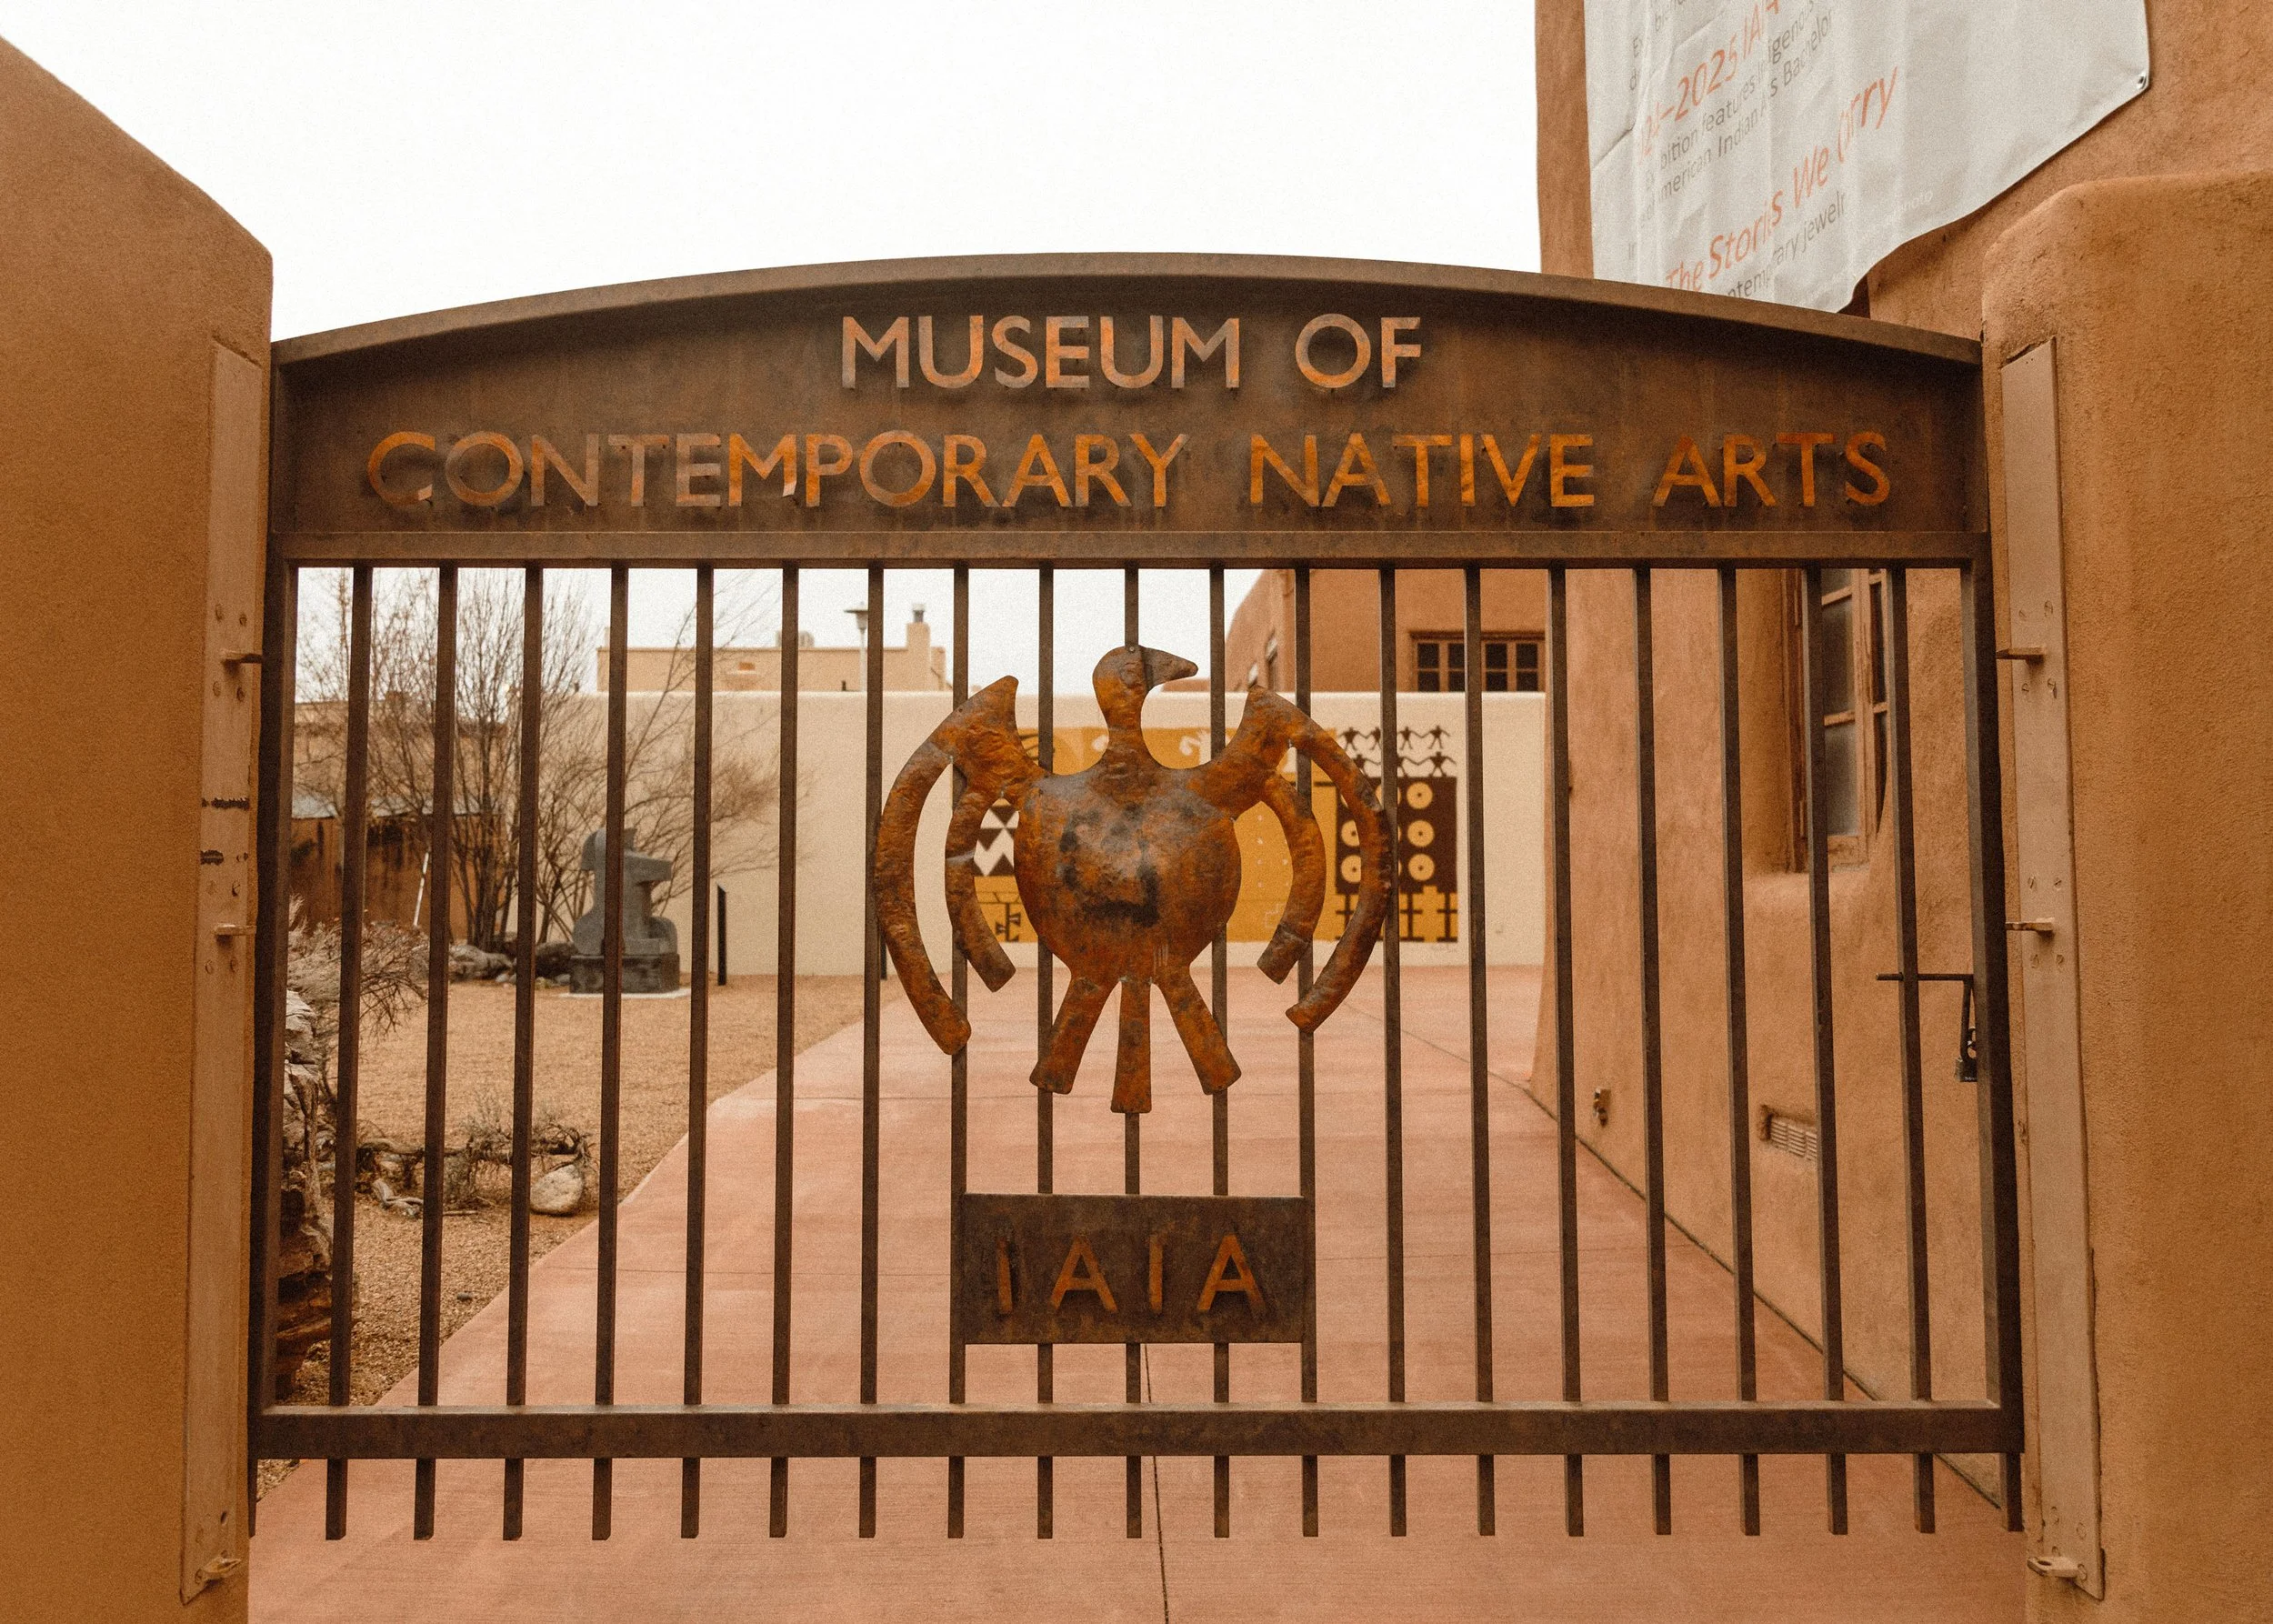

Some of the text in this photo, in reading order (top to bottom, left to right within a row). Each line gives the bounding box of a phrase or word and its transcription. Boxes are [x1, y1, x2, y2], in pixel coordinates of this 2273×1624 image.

[1718, 108, 1757, 157] Indian
[1794, 145, 1829, 208] We
[842, 314, 1422, 389] MUSEUM OF
[367, 429, 1891, 509] CONTEMPORARY NATIVE ARTS
[996, 1231, 1267, 1314] IAIA
